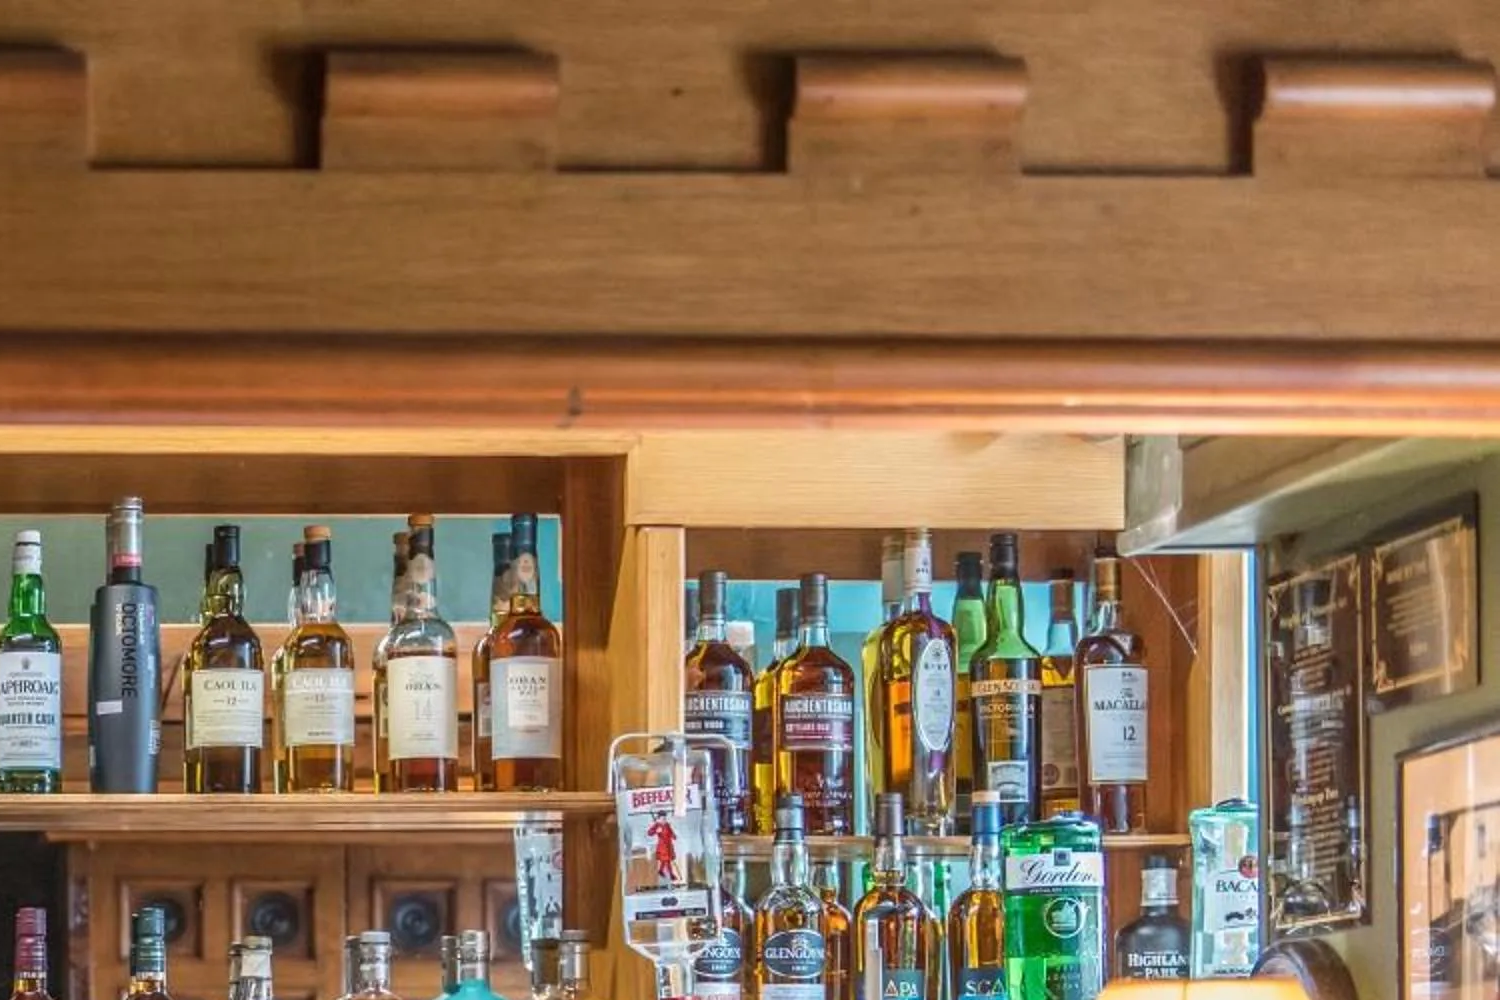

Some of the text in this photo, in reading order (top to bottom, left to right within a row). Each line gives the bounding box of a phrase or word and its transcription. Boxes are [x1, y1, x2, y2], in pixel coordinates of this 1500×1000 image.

[121, 603, 138, 699] OCTOMORE
[203, 679, 239, 692] CAOL
[405, 682, 441, 692] OBAN
[226, 696, 237, 706] 12
[1122, 725, 1136, 741] 12
[632, 787, 694, 809] BEEFEAR
[964, 979, 1005, 998] SCA
